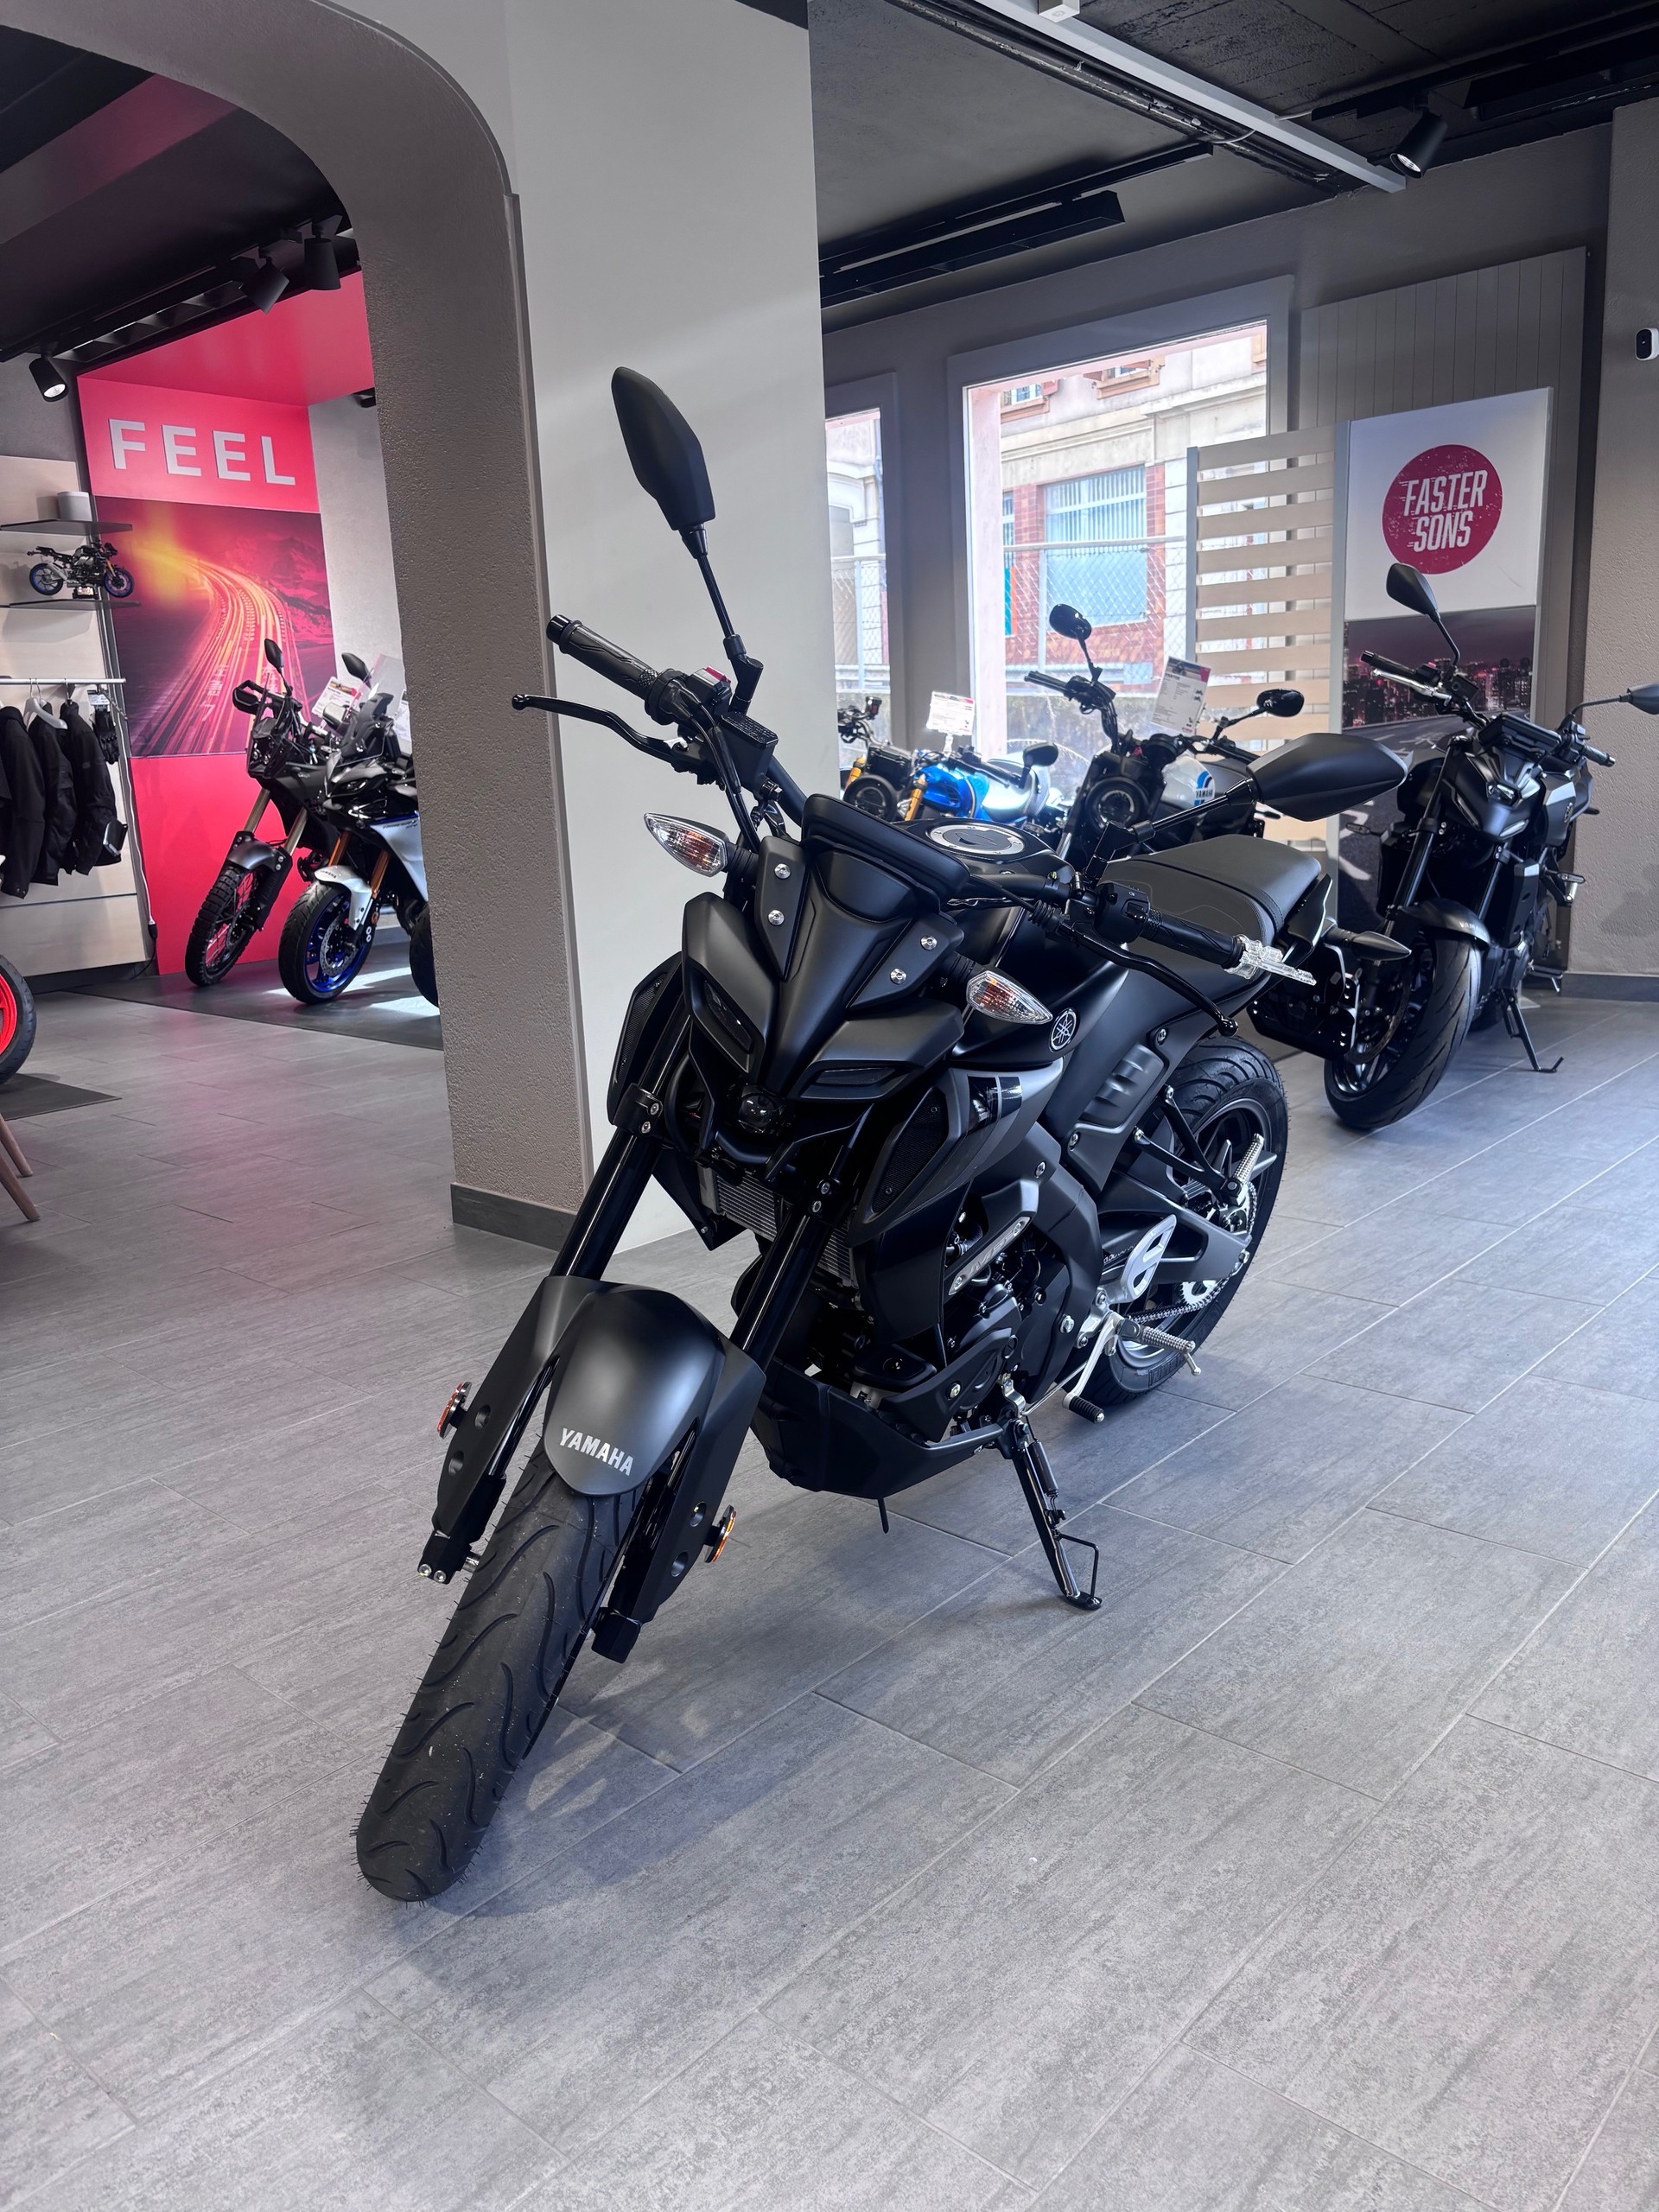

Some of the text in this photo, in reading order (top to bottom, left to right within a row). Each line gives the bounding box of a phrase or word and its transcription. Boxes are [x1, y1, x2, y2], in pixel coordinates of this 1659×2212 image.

[107, 418, 296, 486] FEEL
[1402, 469, 1488, 517] FASTER
[1413, 510, 1473, 552] SONS
[559, 1427, 634, 1476] YAMAHA
